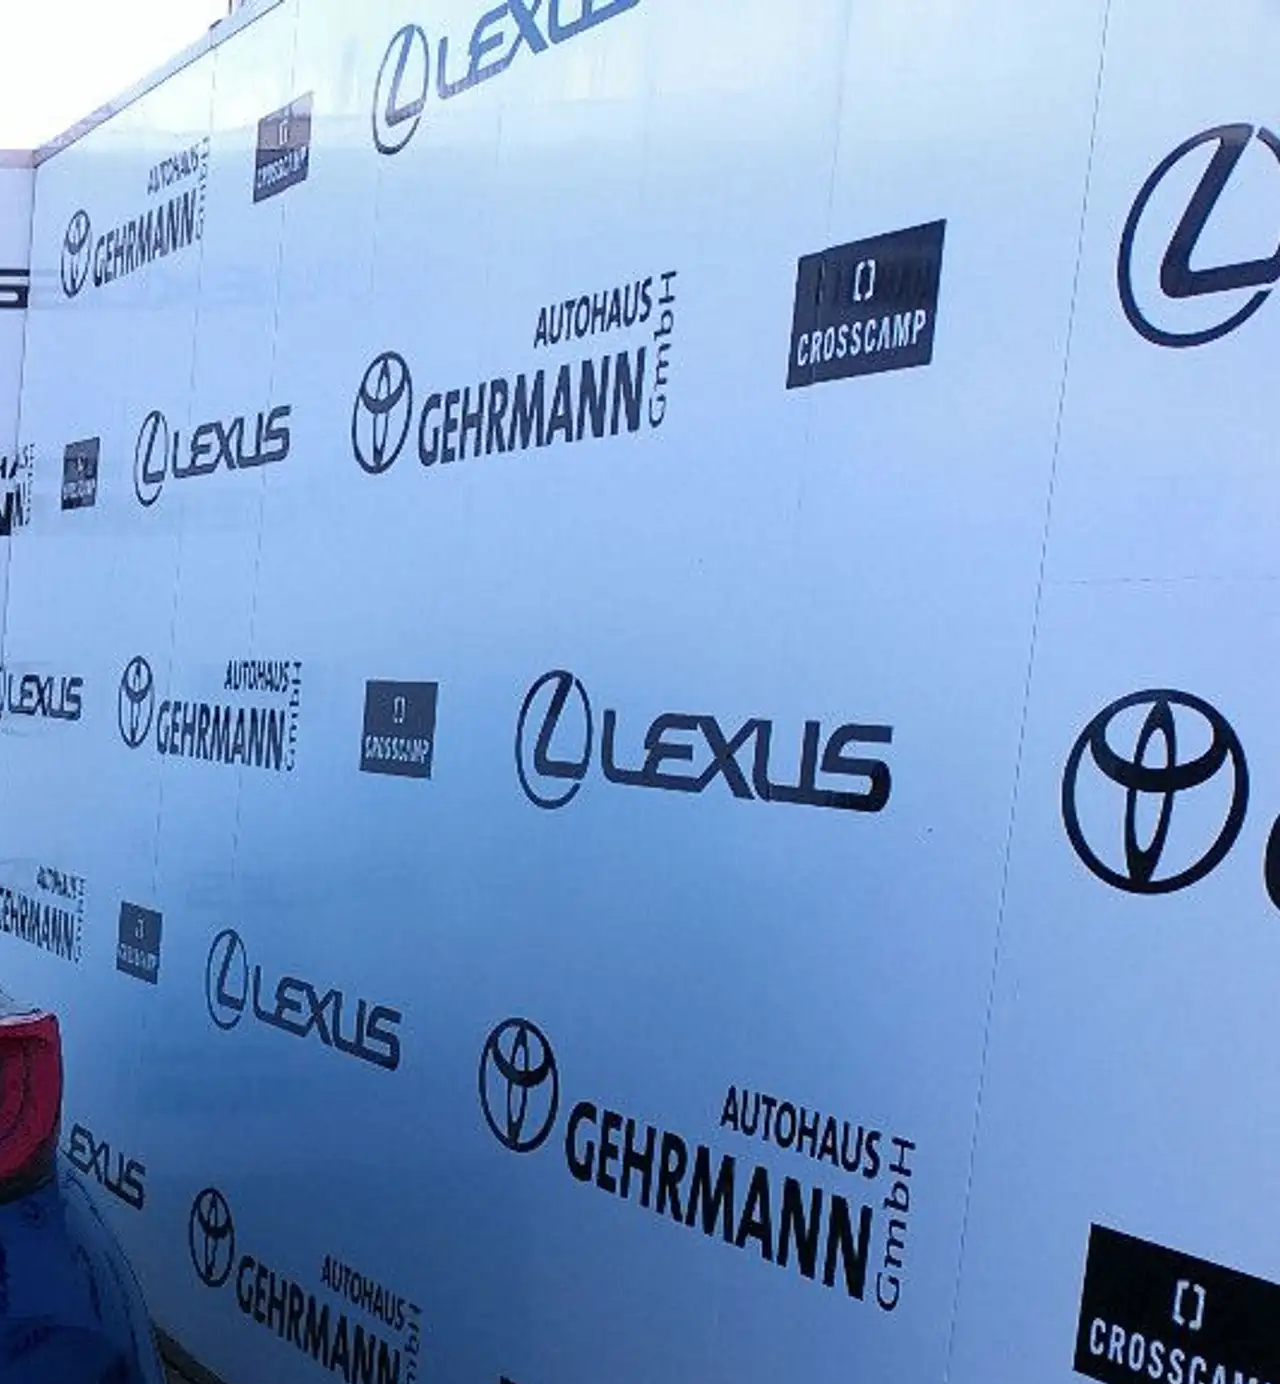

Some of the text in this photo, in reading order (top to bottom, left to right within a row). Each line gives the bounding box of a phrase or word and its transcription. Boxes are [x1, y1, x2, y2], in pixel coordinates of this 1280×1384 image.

[93, 187, 197, 288] GEHRMANN
[534, 277, 652, 348] AUTOHAUS
[648, 271, 677, 428] GmbH
[797, 308, 926, 367] CROSSCAMP
[172, 405, 291, 479] LEXUS
[418, 345, 646, 466] GEHRMANN
[8, 674, 83, 721] LEXUS
[224, 660, 289, 693] AUTOHAUS
[156, 701, 285, 771] GEHRMANN
[601, 709, 893, 812] LEXUS
[253, 966, 401, 1071] LEXUS
[61, 1123, 146, 1211] EXUS
[720, 1085, 881, 1180] AUTOHAUS
[565, 1102, 873, 1302] GEHRMANN
[876, 1136, 916, 1311] GmbH
[320, 1254, 406, 1331] AUTOHAUS
